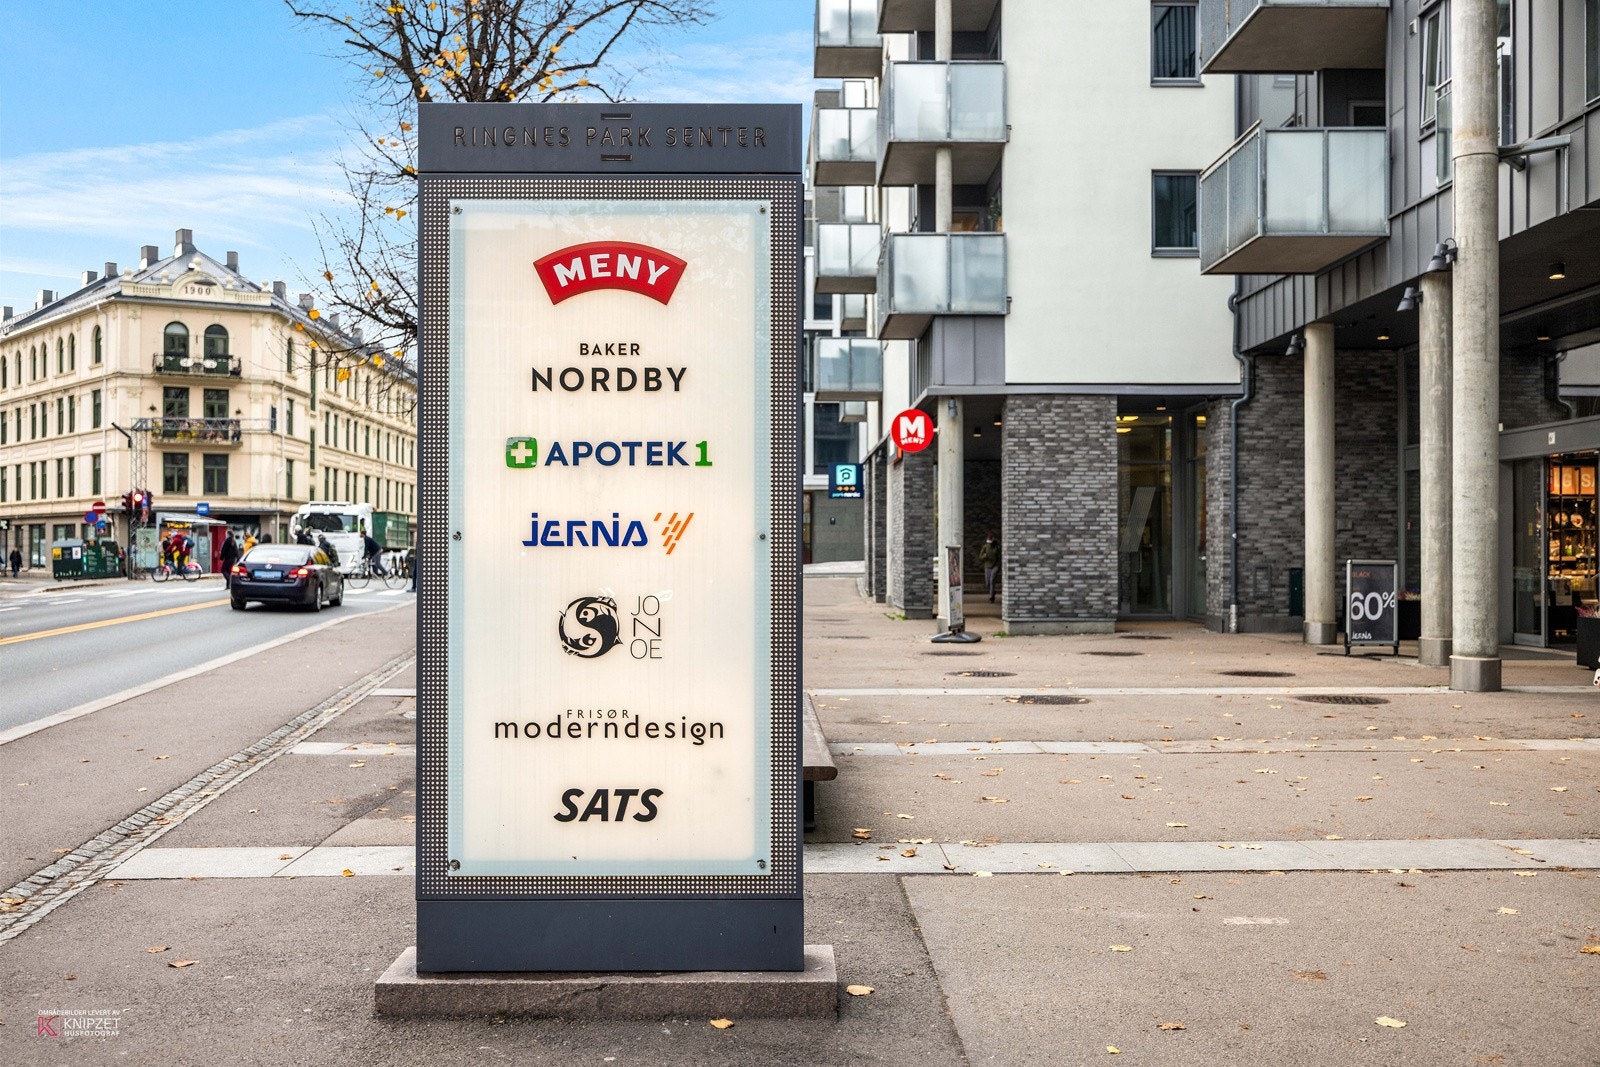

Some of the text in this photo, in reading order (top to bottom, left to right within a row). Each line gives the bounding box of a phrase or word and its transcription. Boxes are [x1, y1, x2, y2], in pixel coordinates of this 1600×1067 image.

[453, 126, 767, 147] RINGNES PARK SENTER
[552, 253, 670, 288] MENY
[185, 286, 211, 295] 1900
[579, 343, 641, 356] BAKER
[531, 367, 688, 392] NORDBY
[899, 416, 925, 439] M
[900, 437, 925, 446] MENY
[545, 440, 713, 467] APOTEK 1
[630, 595, 660, 616] JO
[1351, 591, 1395, 621] 60%
[633, 618, 661, 637] N
[630, 639, 663, 659] OE
[567, 709, 630, 719] FRISØR
[494, 715, 724, 745] moderndesign
[553, 788, 664, 822] SATS
